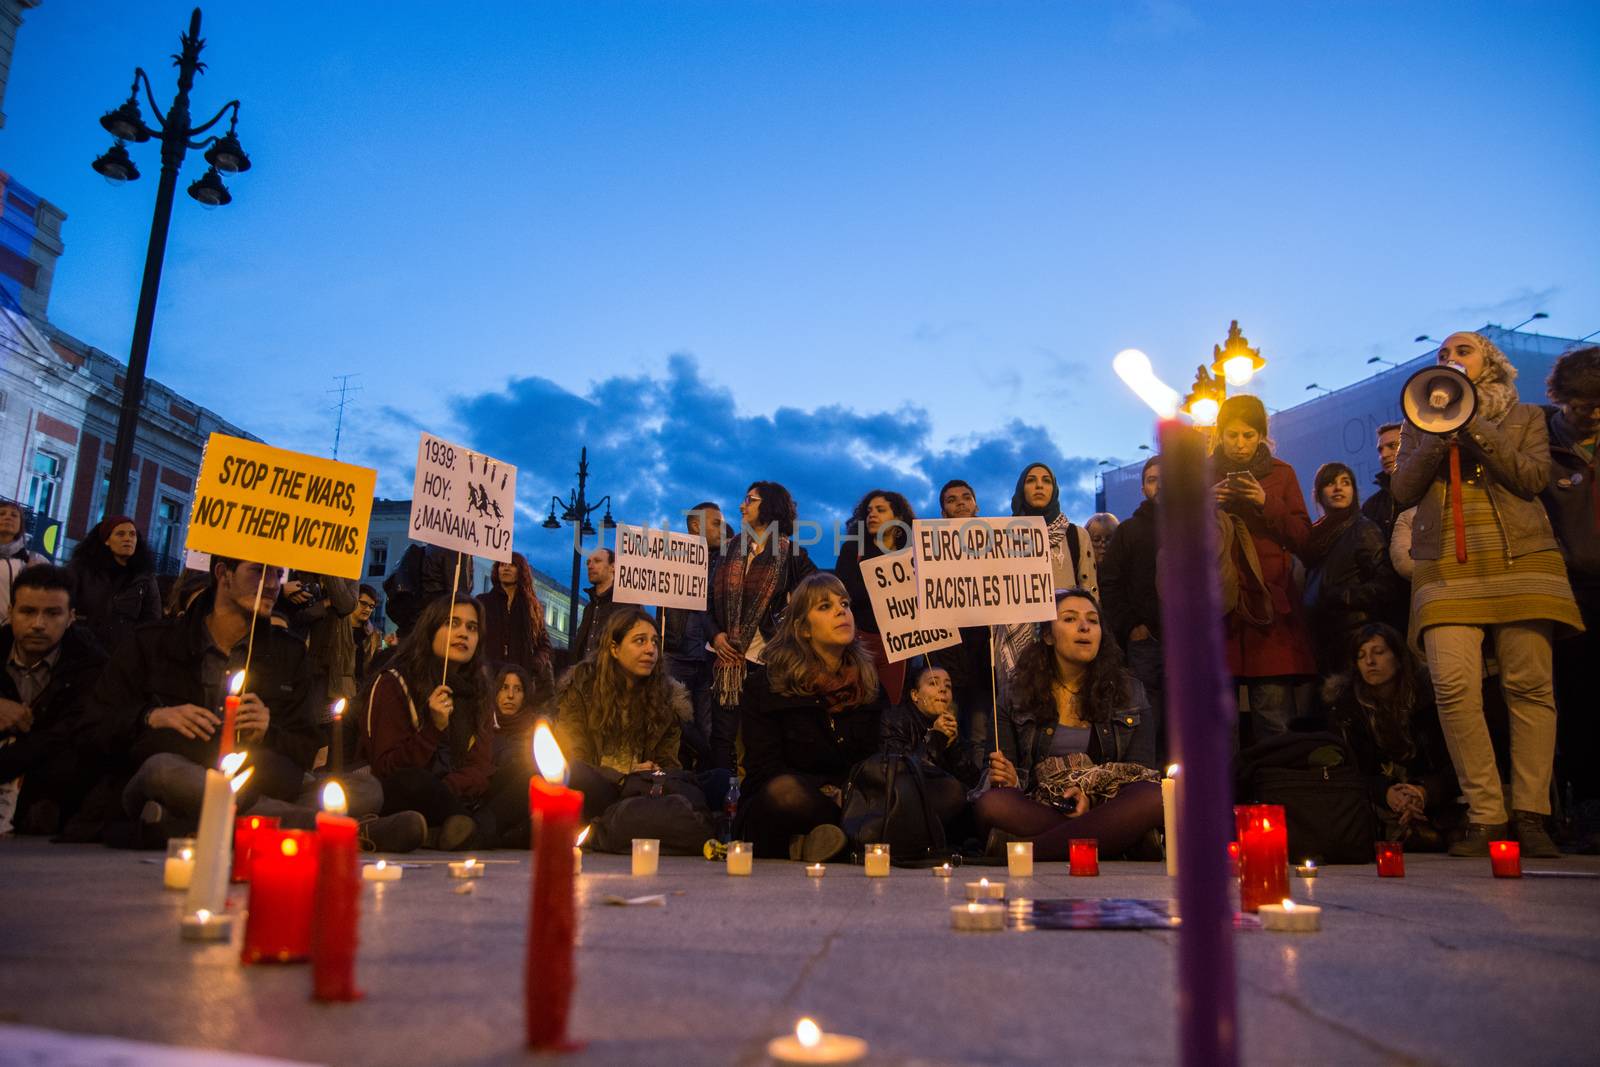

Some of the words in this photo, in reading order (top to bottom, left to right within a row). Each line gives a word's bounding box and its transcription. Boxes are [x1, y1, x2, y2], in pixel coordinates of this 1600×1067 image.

[425, 438, 457, 471] 1939:
[219, 455, 268, 491] STOP
[269, 467, 306, 499] THE
[305, 474, 356, 517] WARS,
[423, 471, 452, 502] HOY:
[194, 496, 238, 530] NOT
[237, 504, 290, 542] THEIR
[292, 515, 359, 556] VICTIMS.
[414, 504, 480, 547] ¿MAÑANA,
[484, 523, 511, 551] TÚ?
[622, 531, 707, 570] EURO-APARTHEID,
[619, 565, 657, 592] RACISTA
[658, 571, 671, 594] ES
[673, 573, 685, 596] TU
[687, 575, 706, 599] LEY!
[925, 576, 981, 610] RACISTA
[983, 575, 1000, 606] ES
[1003, 574, 1020, 605] TU
[1024, 573, 1053, 604] LEY!
[886, 596, 918, 620] Huy
